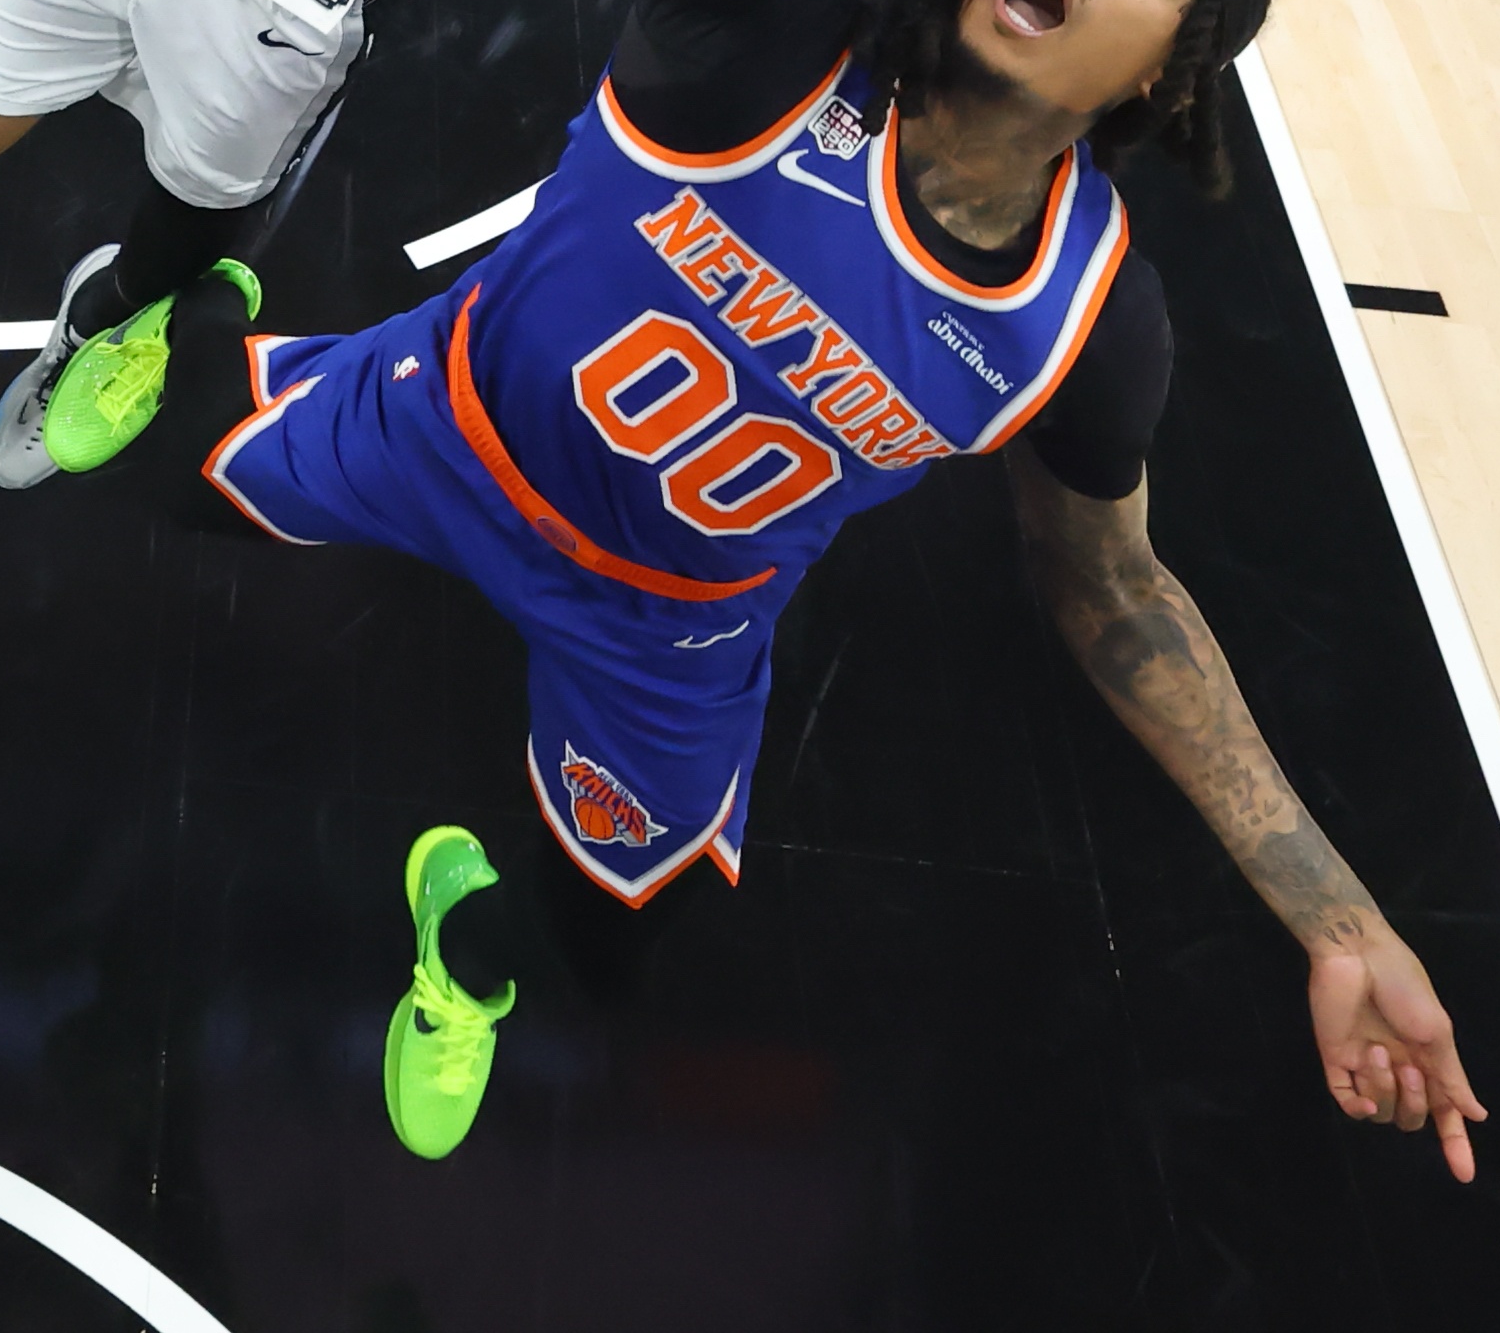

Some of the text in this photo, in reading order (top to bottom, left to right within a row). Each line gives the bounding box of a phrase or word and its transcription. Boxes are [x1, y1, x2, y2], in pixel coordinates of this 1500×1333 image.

[813, 117, 855, 155] 250
[634, 184, 958, 471] NEW YORK
[927, 319, 963, 352] abu
[572, 307, 843, 538] 00
[562, 762, 647, 845] KNICKS
